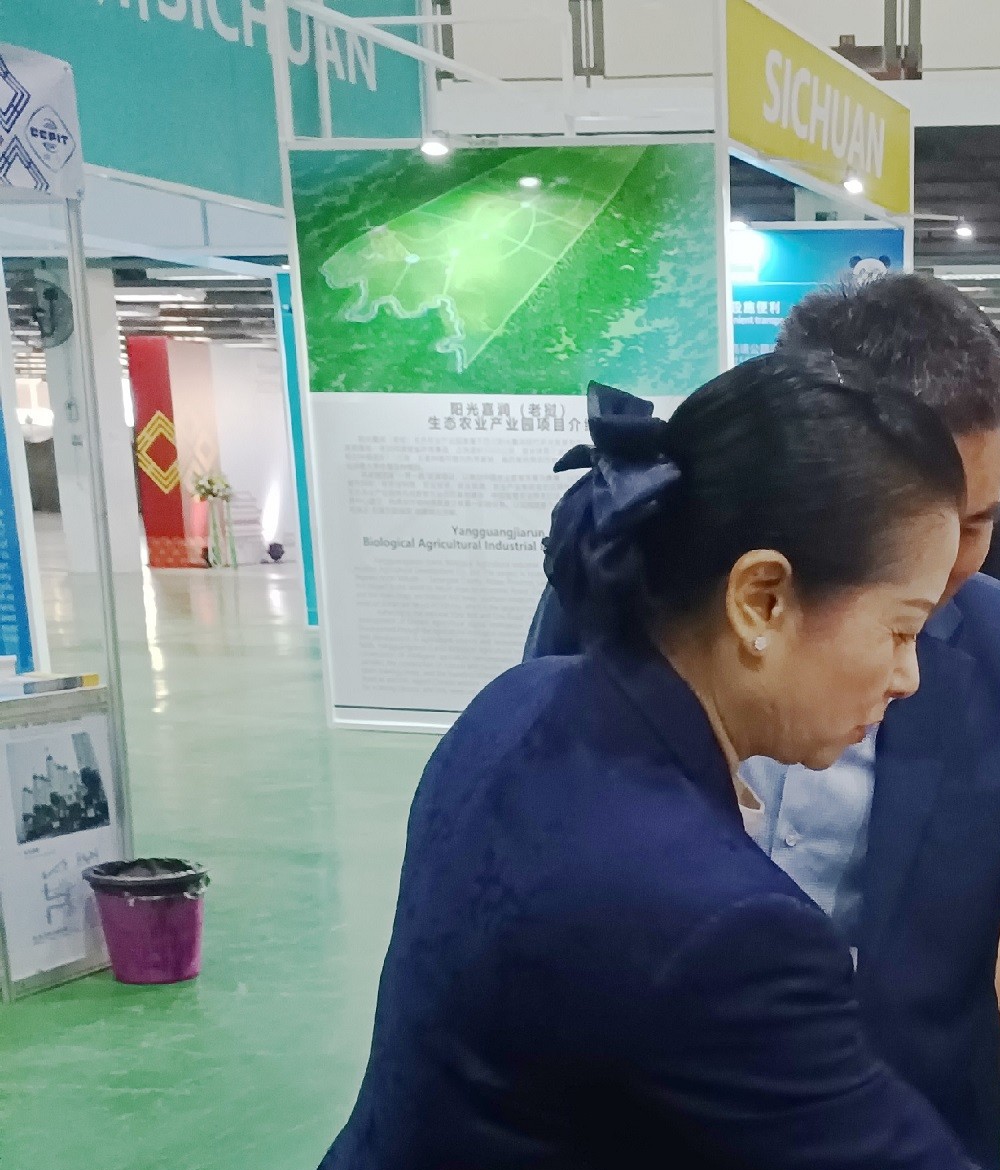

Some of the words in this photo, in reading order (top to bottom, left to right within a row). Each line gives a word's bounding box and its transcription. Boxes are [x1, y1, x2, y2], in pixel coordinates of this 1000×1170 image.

[763, 49, 884, 178] SICHUAN
[363, 537, 415, 550] Biological
[418, 538, 481, 551] Agricultural
[485, 540, 537, 551] Industrial
